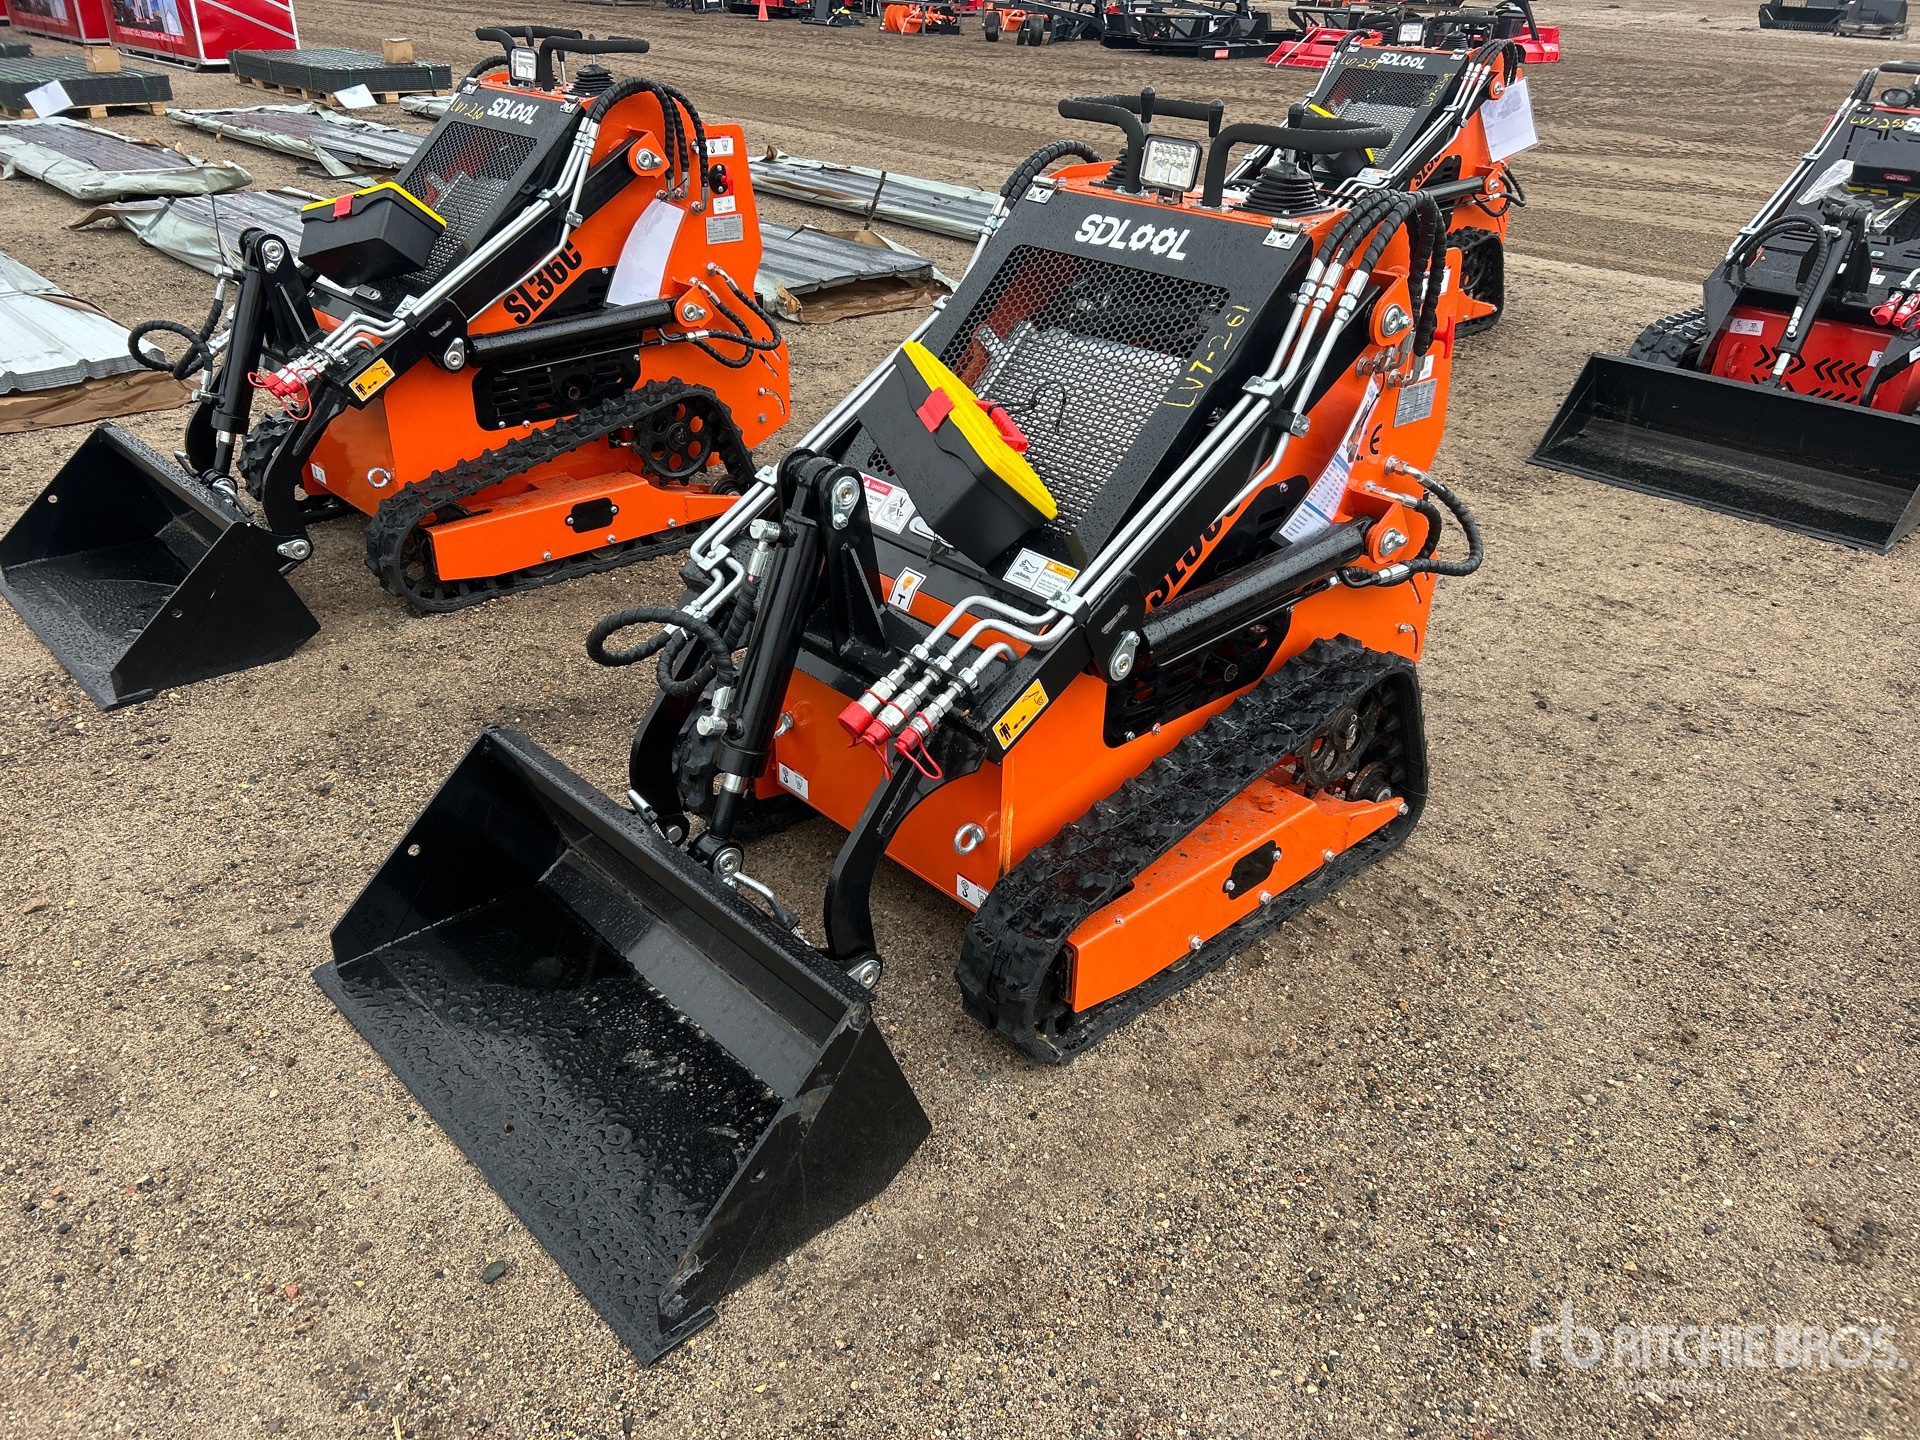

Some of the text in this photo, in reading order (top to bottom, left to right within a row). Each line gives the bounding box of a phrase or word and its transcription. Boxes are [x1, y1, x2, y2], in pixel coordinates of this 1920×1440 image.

[1379, 52, 1427, 70] SDLOOL
[487, 97, 540, 125] SDLOOL
[1074, 213, 1191, 261] SDLOOL
[503, 240, 582, 325] SL36C
[898, 593, 906, 605] T
